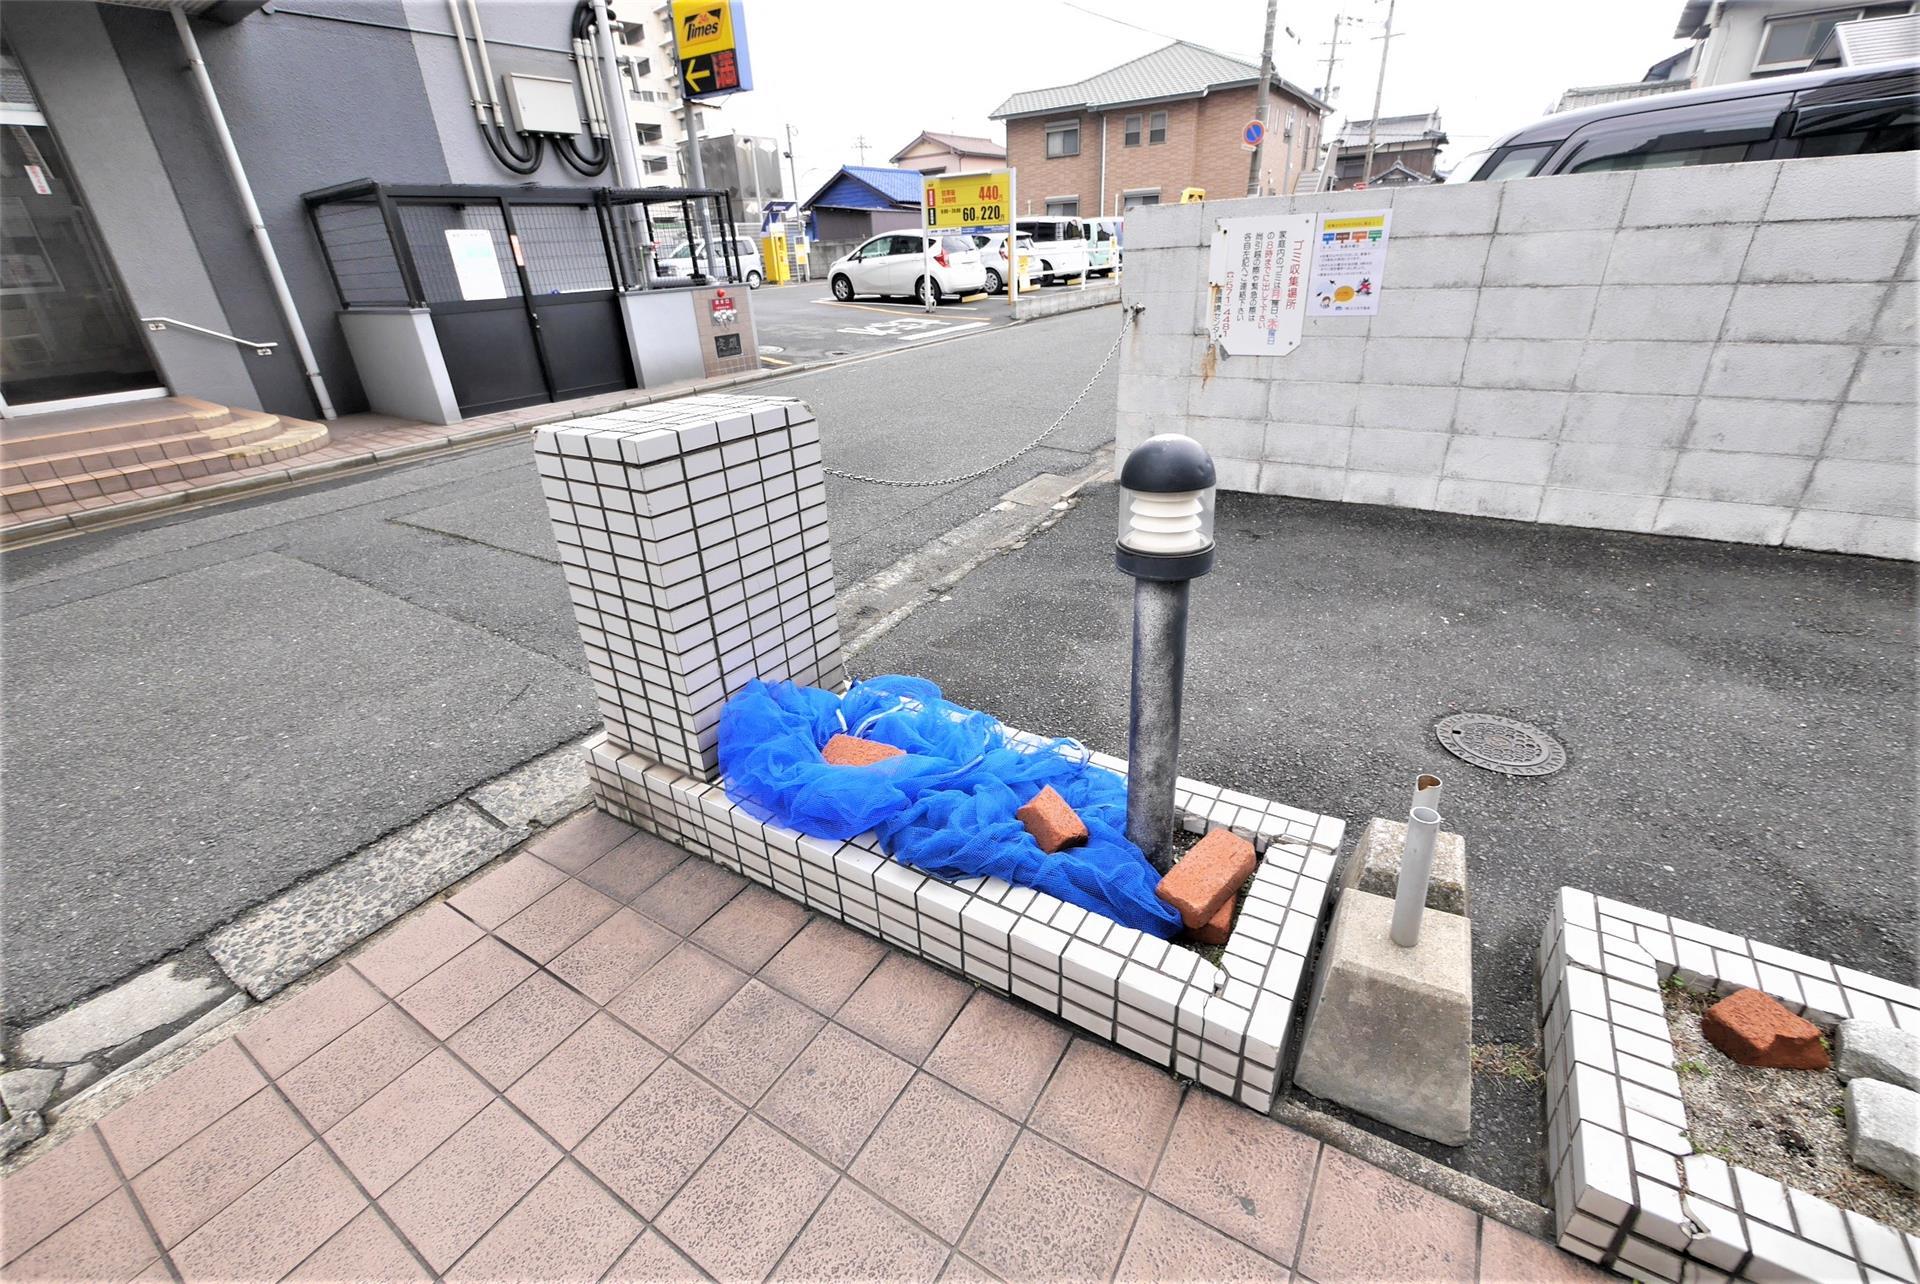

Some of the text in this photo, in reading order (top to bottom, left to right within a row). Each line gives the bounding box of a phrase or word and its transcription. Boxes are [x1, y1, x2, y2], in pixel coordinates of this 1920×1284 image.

[687, 22, 718, 41] Times
[1286, 240, 1304, 310] ゴミ収集場所
